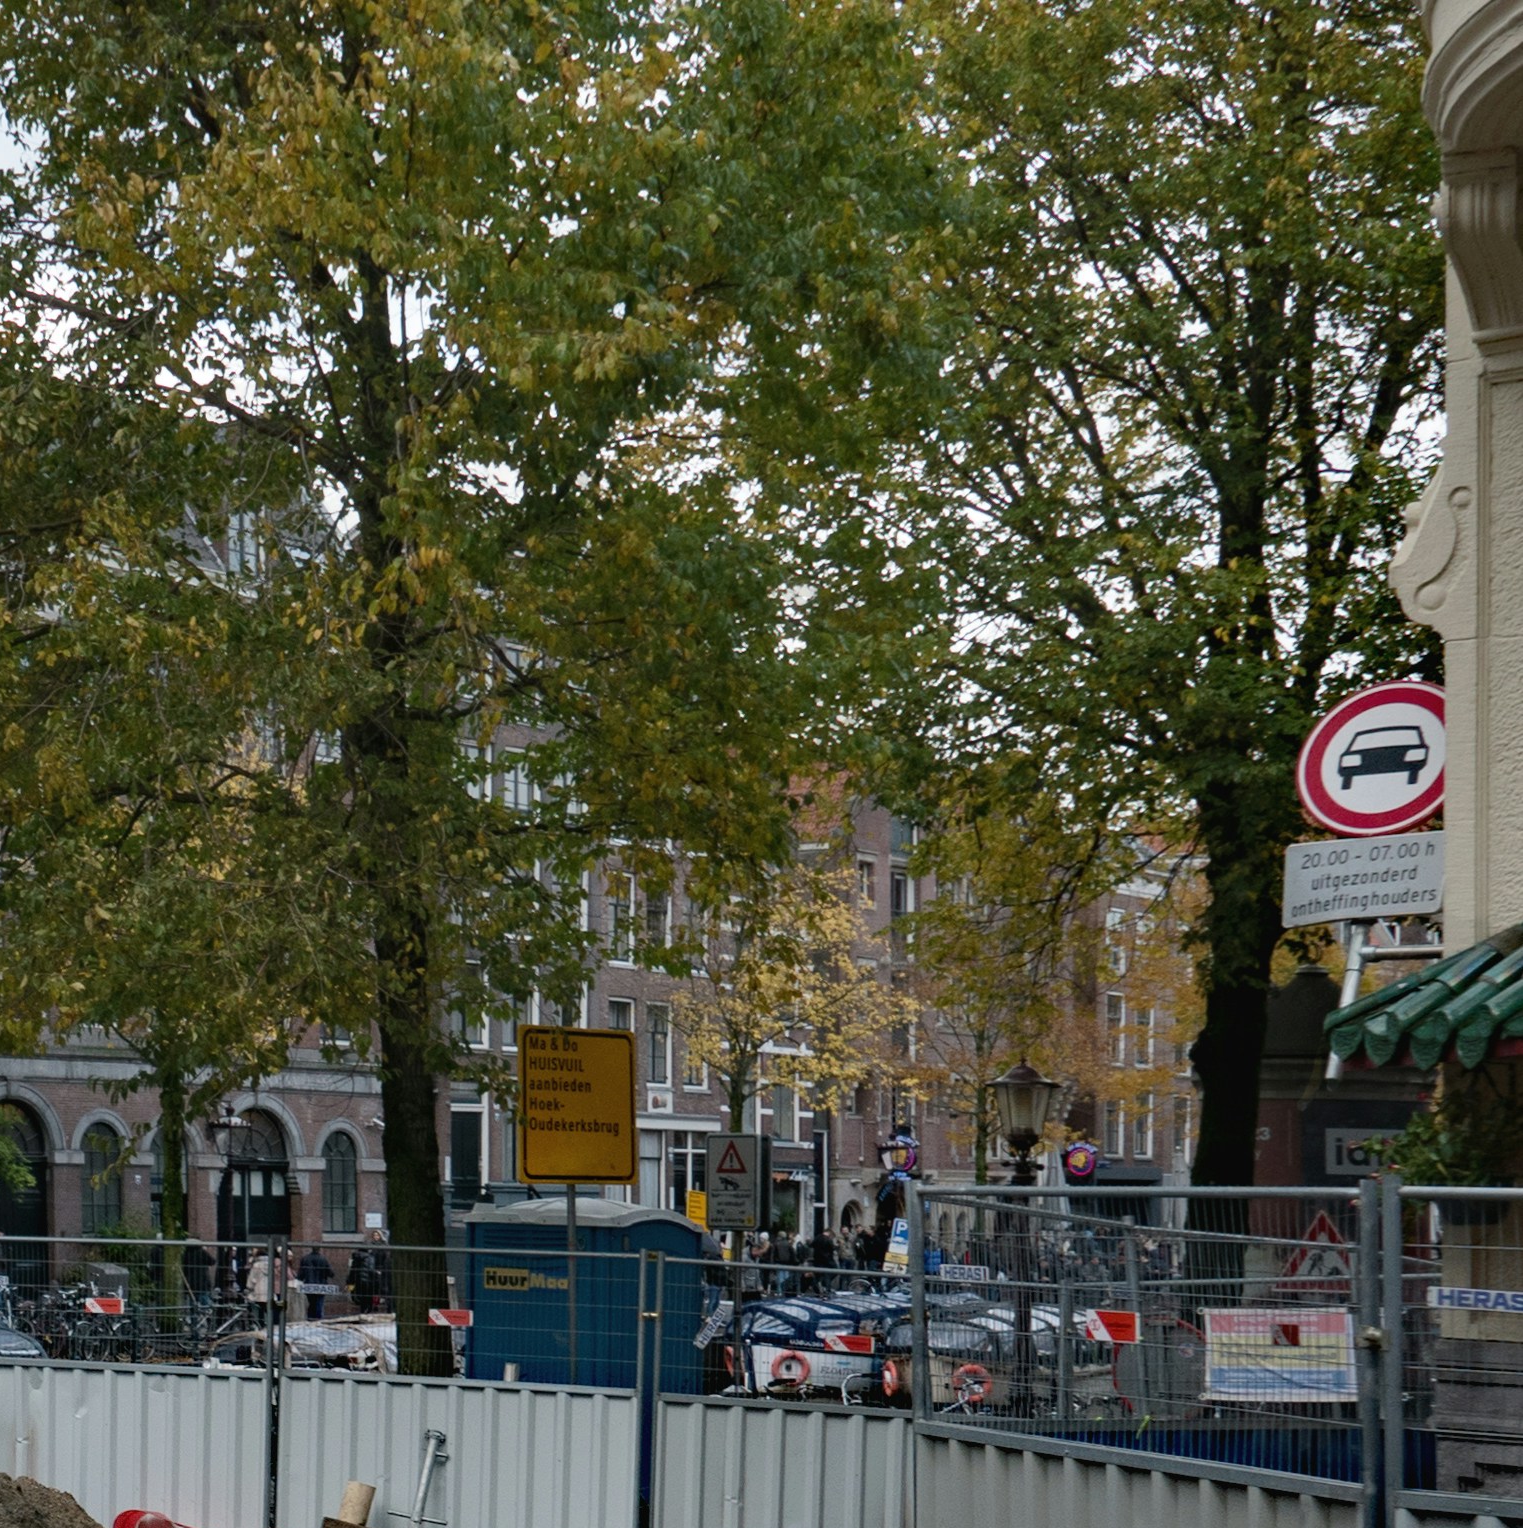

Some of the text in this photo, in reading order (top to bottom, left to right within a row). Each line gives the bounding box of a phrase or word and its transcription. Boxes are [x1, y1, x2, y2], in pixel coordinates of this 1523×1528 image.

[1301, 849, 1349, 870] 20.00
[1369, 842, 1420, 862] 07.00
[1425, 841, 1435, 857] h
[1311, 865, 1418, 892] uitgezonderd
[1291, 888, 1437, 918] ontheffinghouders
[529, 1036, 578, 1052] Ma & Do
[529, 1057, 584, 1072] HUISVUIL
[529, 1077, 592, 1093] aanbieden
[529, 1097, 565, 1111] Hoek-
[529, 1117, 620, 1137] Oudekerksbrug
[1437, 1288, 1523, 1311] HERAS
